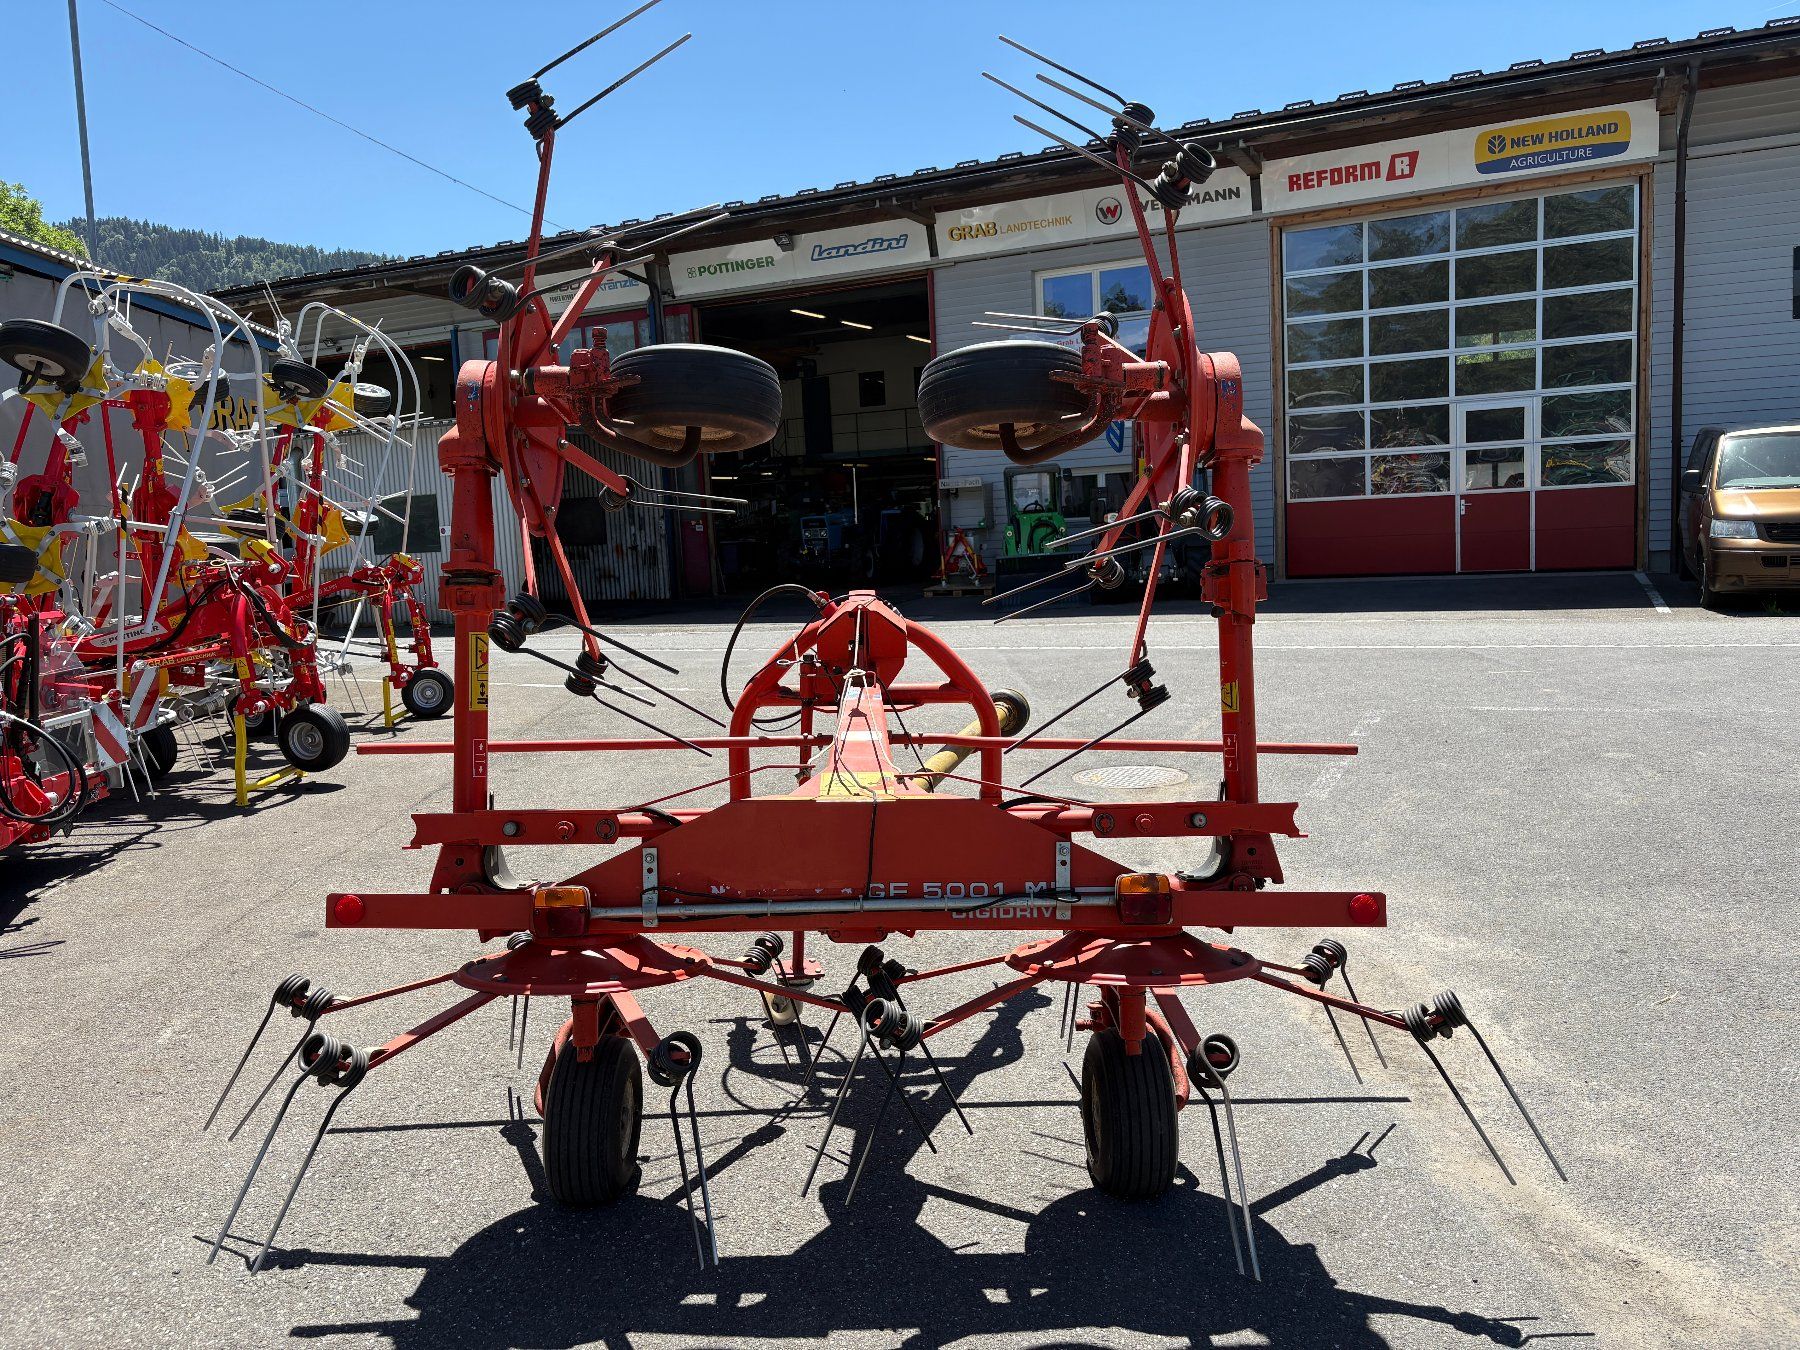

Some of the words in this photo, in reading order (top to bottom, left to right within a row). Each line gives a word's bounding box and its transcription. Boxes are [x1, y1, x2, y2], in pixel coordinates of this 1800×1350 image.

[1510, 132, 1544, 149] NEW
[1548, 122, 1619, 144] HOLLAND
[1509, 147, 1593, 169] AGRICULTURE
[1287, 161, 1381, 192] REFORM
[948, 221, 998, 241] GRAB
[1000, 215, 1073, 234] LANDTECHNIK
[811, 233, 909, 261] Landini
[148, 656, 175, 667] GRAB
[869, 882, 909, 899] GF
[923, 882, 1004, 898] 5001
[952, 907, 1054, 919] DIGIDRIV
